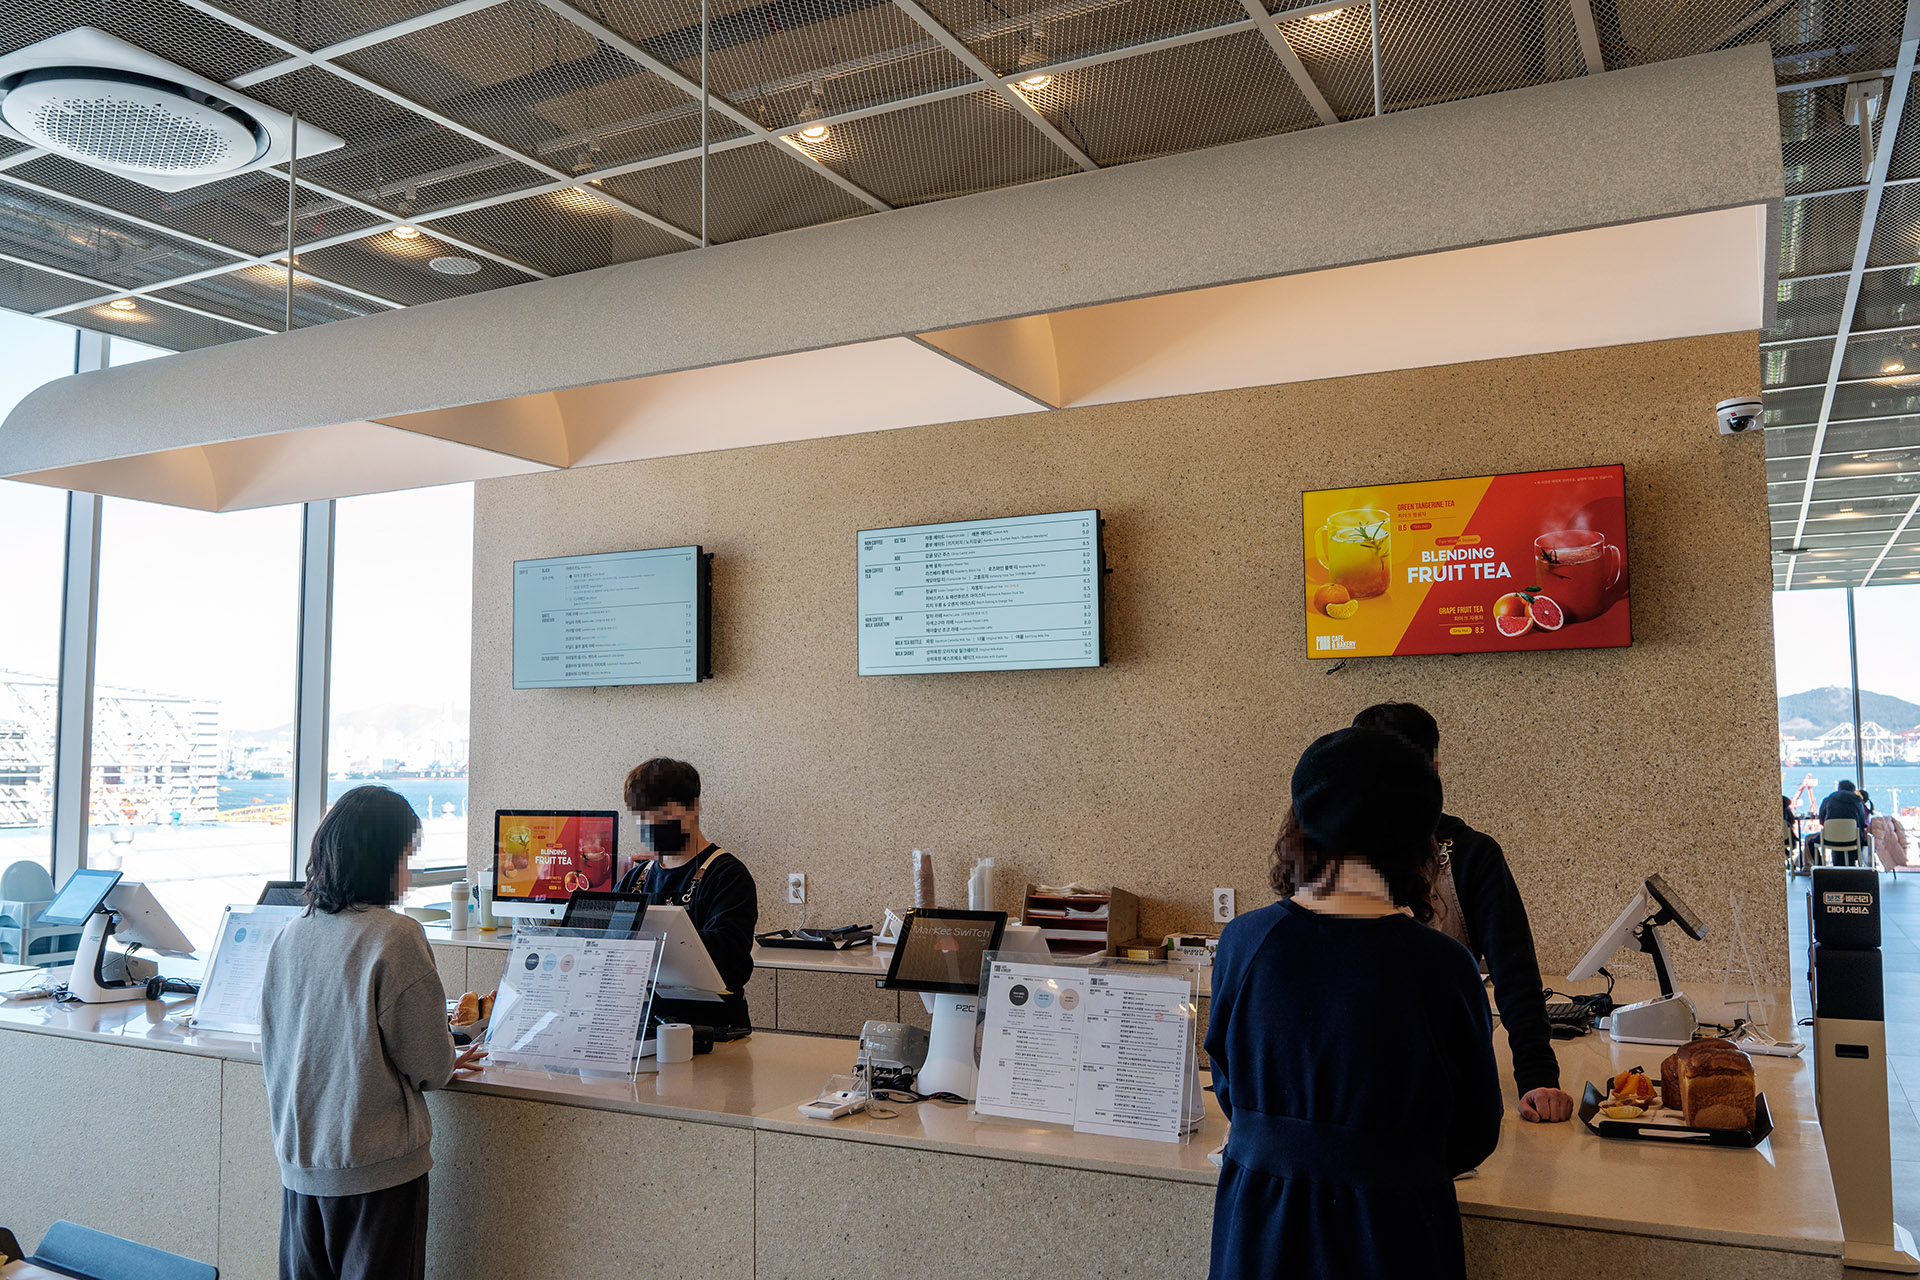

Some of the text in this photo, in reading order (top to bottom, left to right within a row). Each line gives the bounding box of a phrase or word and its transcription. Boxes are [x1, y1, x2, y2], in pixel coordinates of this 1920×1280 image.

[1416, 501, 1444, 509] TANGERINE
[1422, 547, 1494, 562] BLENDING
[1408, 562, 1512, 583] FRUIT TEA
[535, 856, 572, 865] FRUIT TEA
[956, 1004, 975, 1013] P2C
